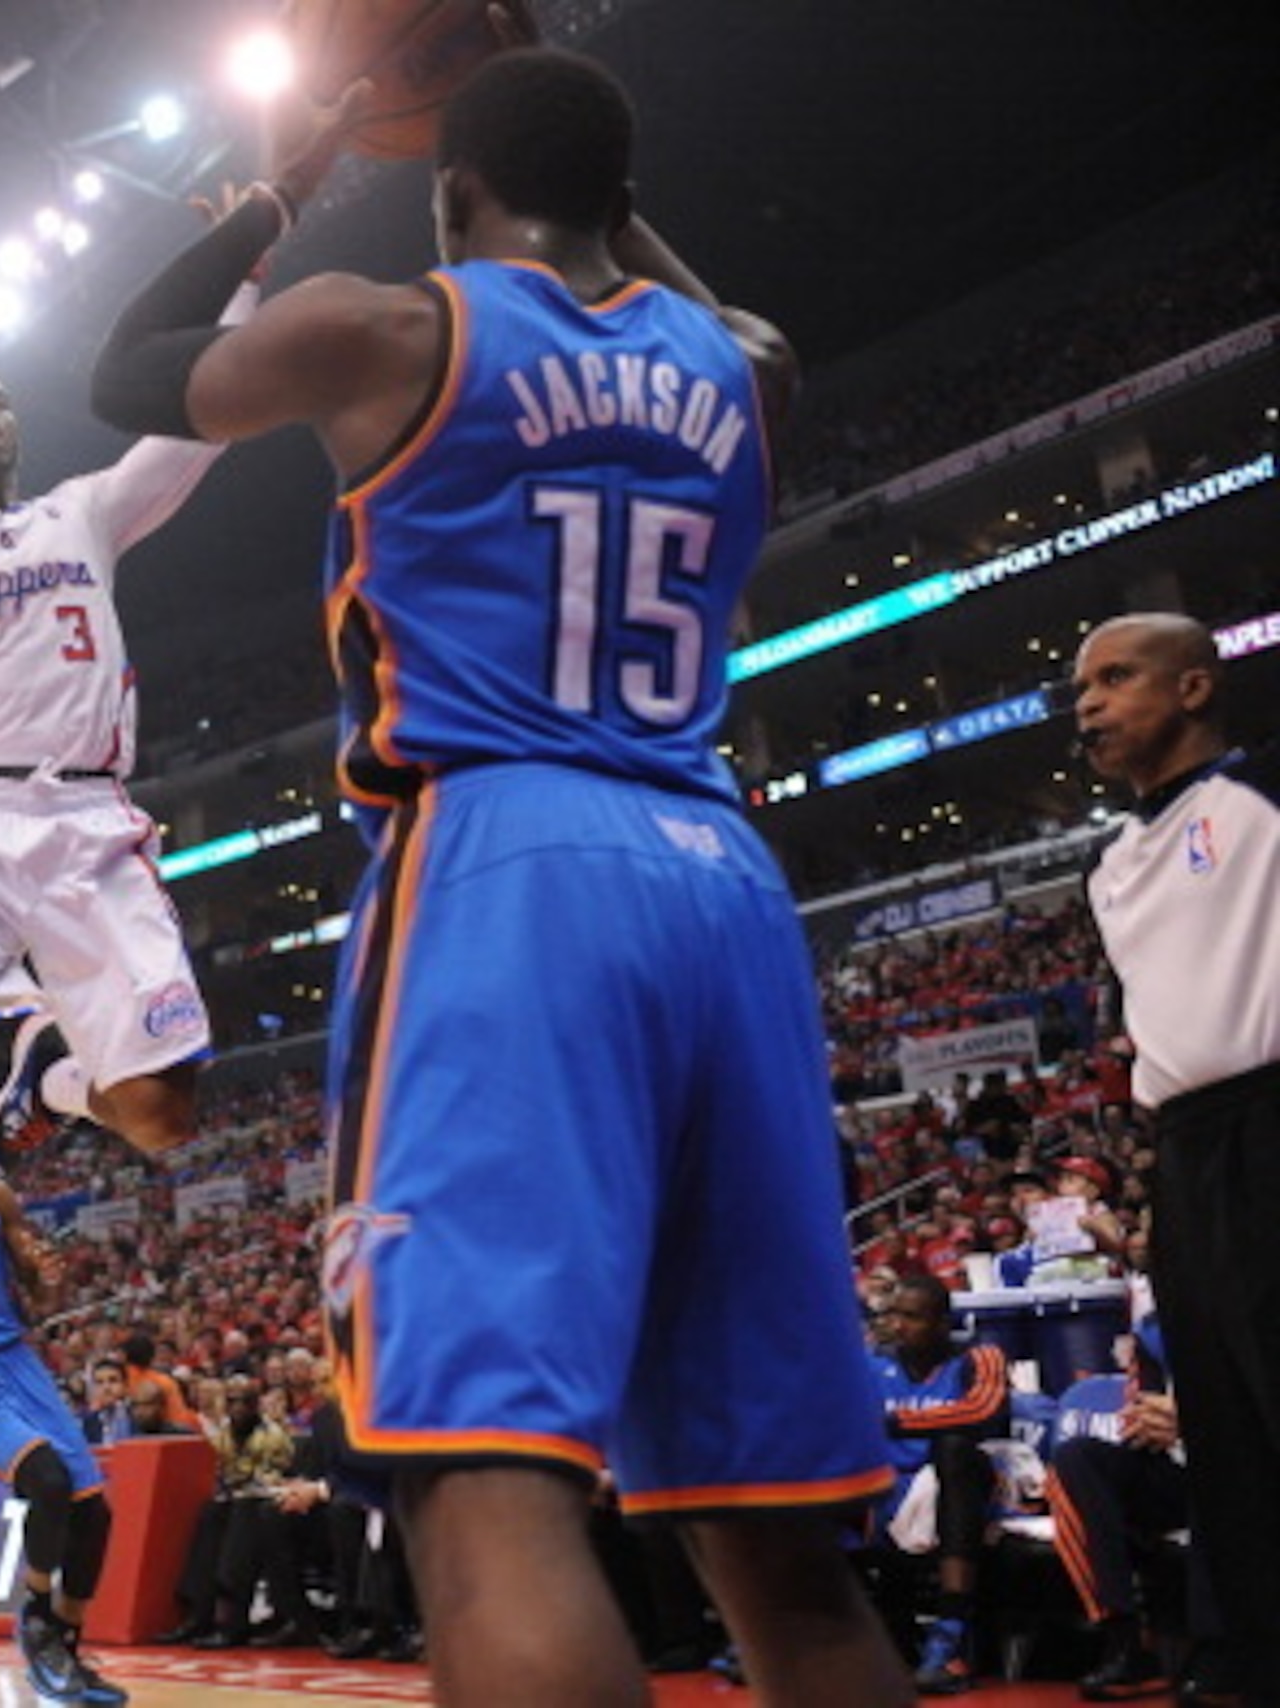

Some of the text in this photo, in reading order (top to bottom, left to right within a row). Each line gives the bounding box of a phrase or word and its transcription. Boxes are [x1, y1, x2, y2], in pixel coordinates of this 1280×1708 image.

[506, 352, 746, 474] JACKSON
[951, 538, 1054, 596] SUPPORT
[1056, 500, 1162, 556] CLIPPER
[56, 606, 96, 661] 3
[533, 489, 715, 724] 15
